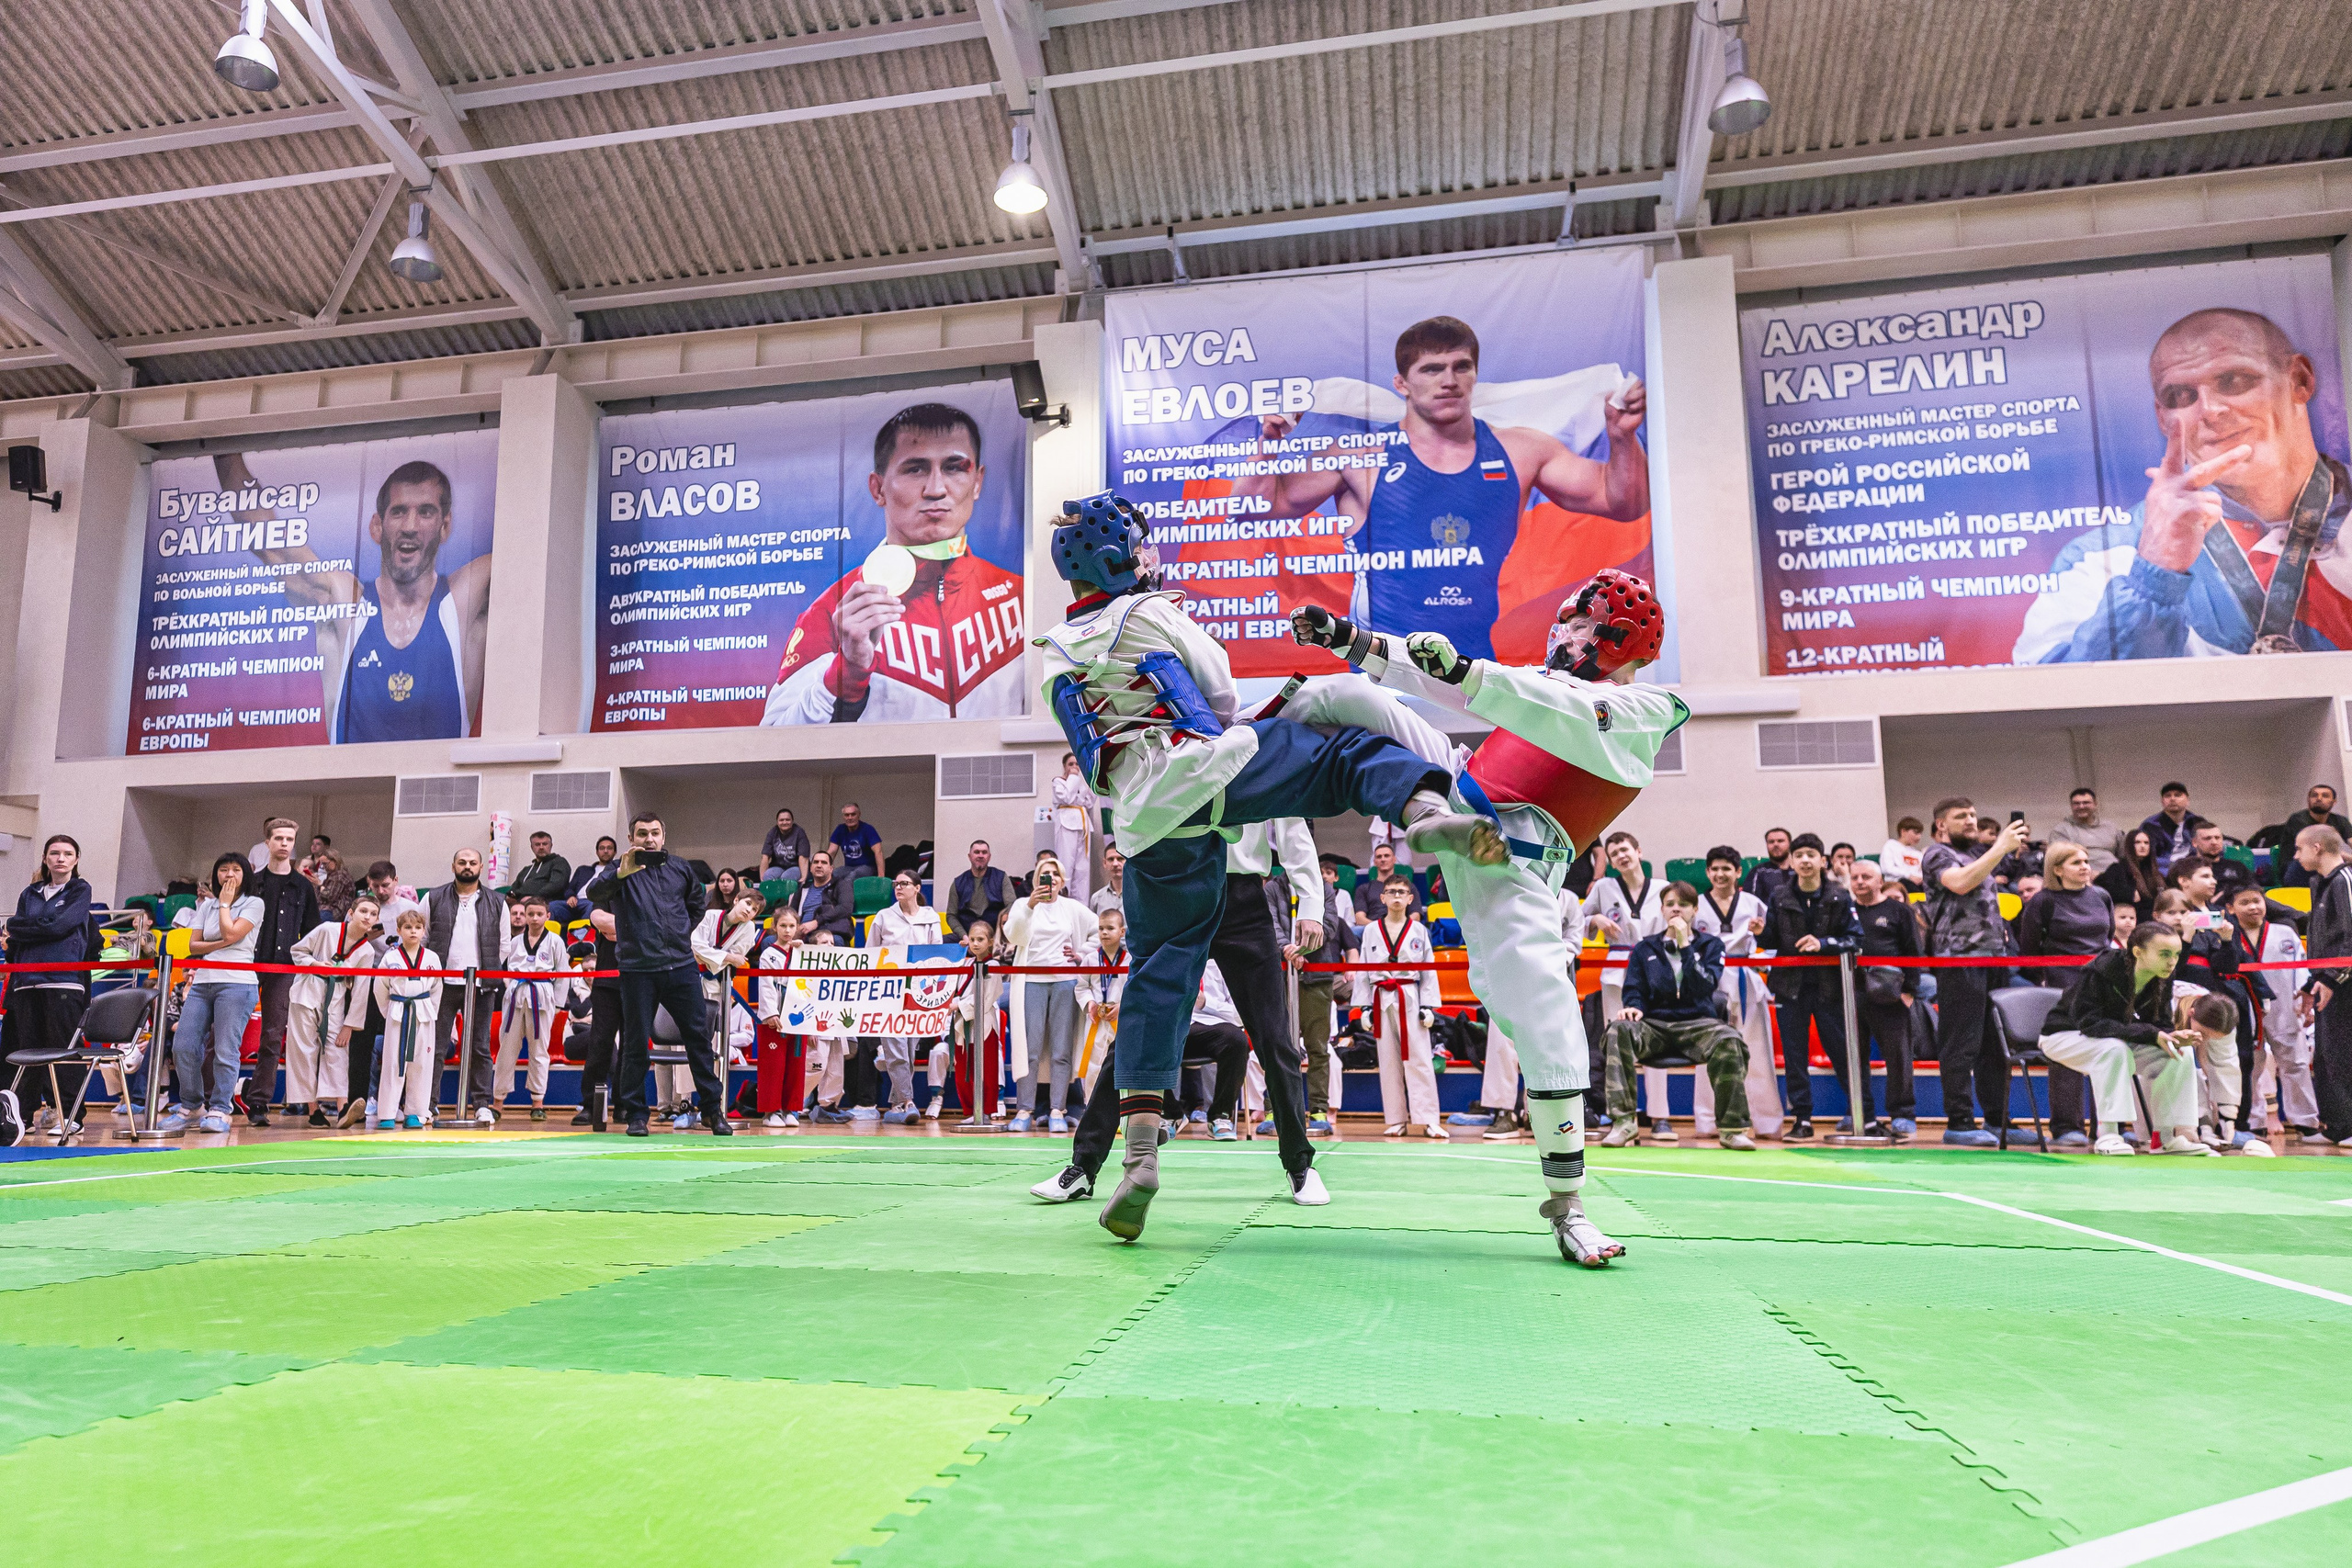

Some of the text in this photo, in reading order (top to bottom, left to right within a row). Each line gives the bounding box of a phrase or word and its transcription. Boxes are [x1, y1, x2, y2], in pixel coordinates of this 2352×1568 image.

[1761, 300, 2044, 357] Александр
[1122, 327, 1257, 372] МУСА
[1763, 346, 2008, 407] КАРЕЛИН
[1122, 377, 1314, 426] ЕВЛОЕВ
[1767, 396, 2080, 438] ЗАСЛУЖЕННЫЙ МАСТЕР СПОРТА
[1123, 430, 1409, 463] ЗАСЛУЖЕННЫЙ МАСТЕР СПОРТА
[1768, 418, 2058, 458] ПО ГРЕКО-РИМСКОЙ БОРЬБЕ
[610, 442, 736, 478] Роман
[1123, 453, 1388, 484] ПО ГРЕКО-РИМСКОЙ БОРЬБЕ
[1770, 447, 2030, 491] ГЕРОЙ РОССИЙСКОЙ
[159, 479, 320, 521] Бувайсар
[610, 479, 761, 523] ВЛАСОВ
[1773, 483, 1925, 513] ФЕДЕРАЦИИ
[157, 517, 309, 558] САЙТИЕВ
[1308, 515, 1354, 536] ИГР
[1776, 505, 2132, 549] ТРЁХКРАТНЫЙ ПОБЕДИТЕЛЬ
[610, 527, 851, 558] ЗАСЛУЖЕННЫЙ МАСТЕР СПОРТА
[1778, 536, 2028, 571] ОЛИМПИЙСКИХ ИГР
[156, 558, 352, 585] ЗАСЛУЖЕННЫЙ МАСТЕР СПОРТА
[610, 547, 823, 575] ПО ГРЕКО-РИМСКОЙ БОРЬБЕ
[1284, 552, 1406, 574] ЧЕМПИОН
[1411, 547, 1483, 567] МИРА
[154, 581, 285, 603] ПО ВОЛЬНОЙ БОРЬБЕ
[610, 581, 806, 610] ДВУКРАТНЫЙ ПОБЕДИТЕЛЬ
[1424, 597, 1472, 605] ALROSA
[1780, 572, 2060, 607] 9-КРАТНЫЙ ЧЕМПИОН
[153, 602, 378, 630] ТРЁХКРАТНЫЙ ПОБЕДИТЕЛЬ
[610, 603, 752, 626] ОЛИМПИЙСКИХ ИГР
[1181, 591, 1279, 617] РАТНЫЙ
[1245, 619, 1292, 640] ЕВР
[1782, 609, 1855, 631] МИРА
[151, 626, 309, 650] ОЛИМПИЙСКИХ ИГР
[610, 635, 767, 658] 3-КРАТНЫЙ ЧЕМПИОН
[876, 596, 1024, 689] ОССИЯ
[609, 658, 644, 675] МИРА
[1786, 637, 1945, 669] 12-КРАТНЫЙ
[147, 656, 324, 681] 6-КРАТНЫЙ ЧЕМПИОН
[145, 684, 188, 700] МИРА
[606, 685, 766, 706] 4-КРАТНЫЙ ЧЕМПИОН
[142, 707, 321, 731] 6-КРАТНЫЙ ЧЕМПИОН
[605, 707, 666, 724] ЕВРОПЫ
[139, 733, 209, 750] ЕВРОПЫ
[799, 950, 869, 970] ЖУКОВ
[818, 976, 902, 1002] ВПЕРЁД!
